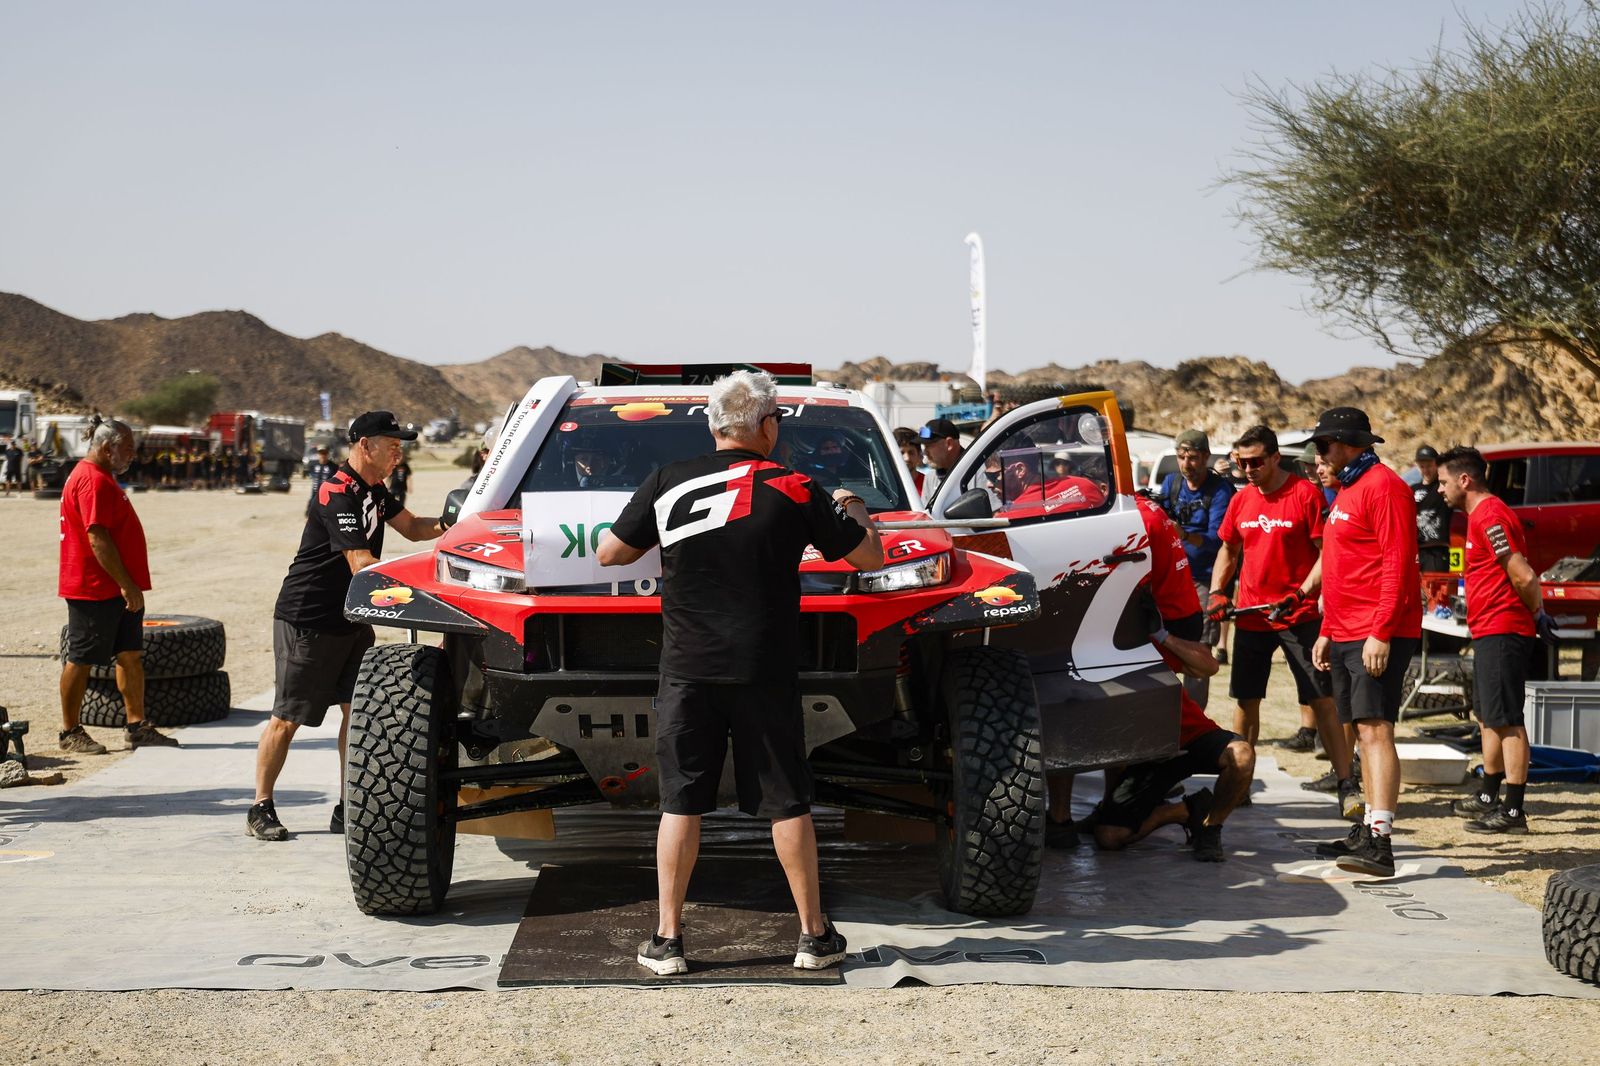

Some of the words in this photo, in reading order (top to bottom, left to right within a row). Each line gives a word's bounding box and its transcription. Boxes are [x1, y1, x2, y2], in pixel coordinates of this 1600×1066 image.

[508, 410, 530, 437] TOYOTA
[493, 438, 512, 466] GAZOO
[475, 467, 498, 495] Racing
[453, 542, 504, 558] GR
[887, 539, 927, 560] GR
[350, 605, 405, 619] repsol
[983, 603, 1032, 618] repsol
[578, 714, 649, 738] HI
[233, 951, 507, 970] ove
